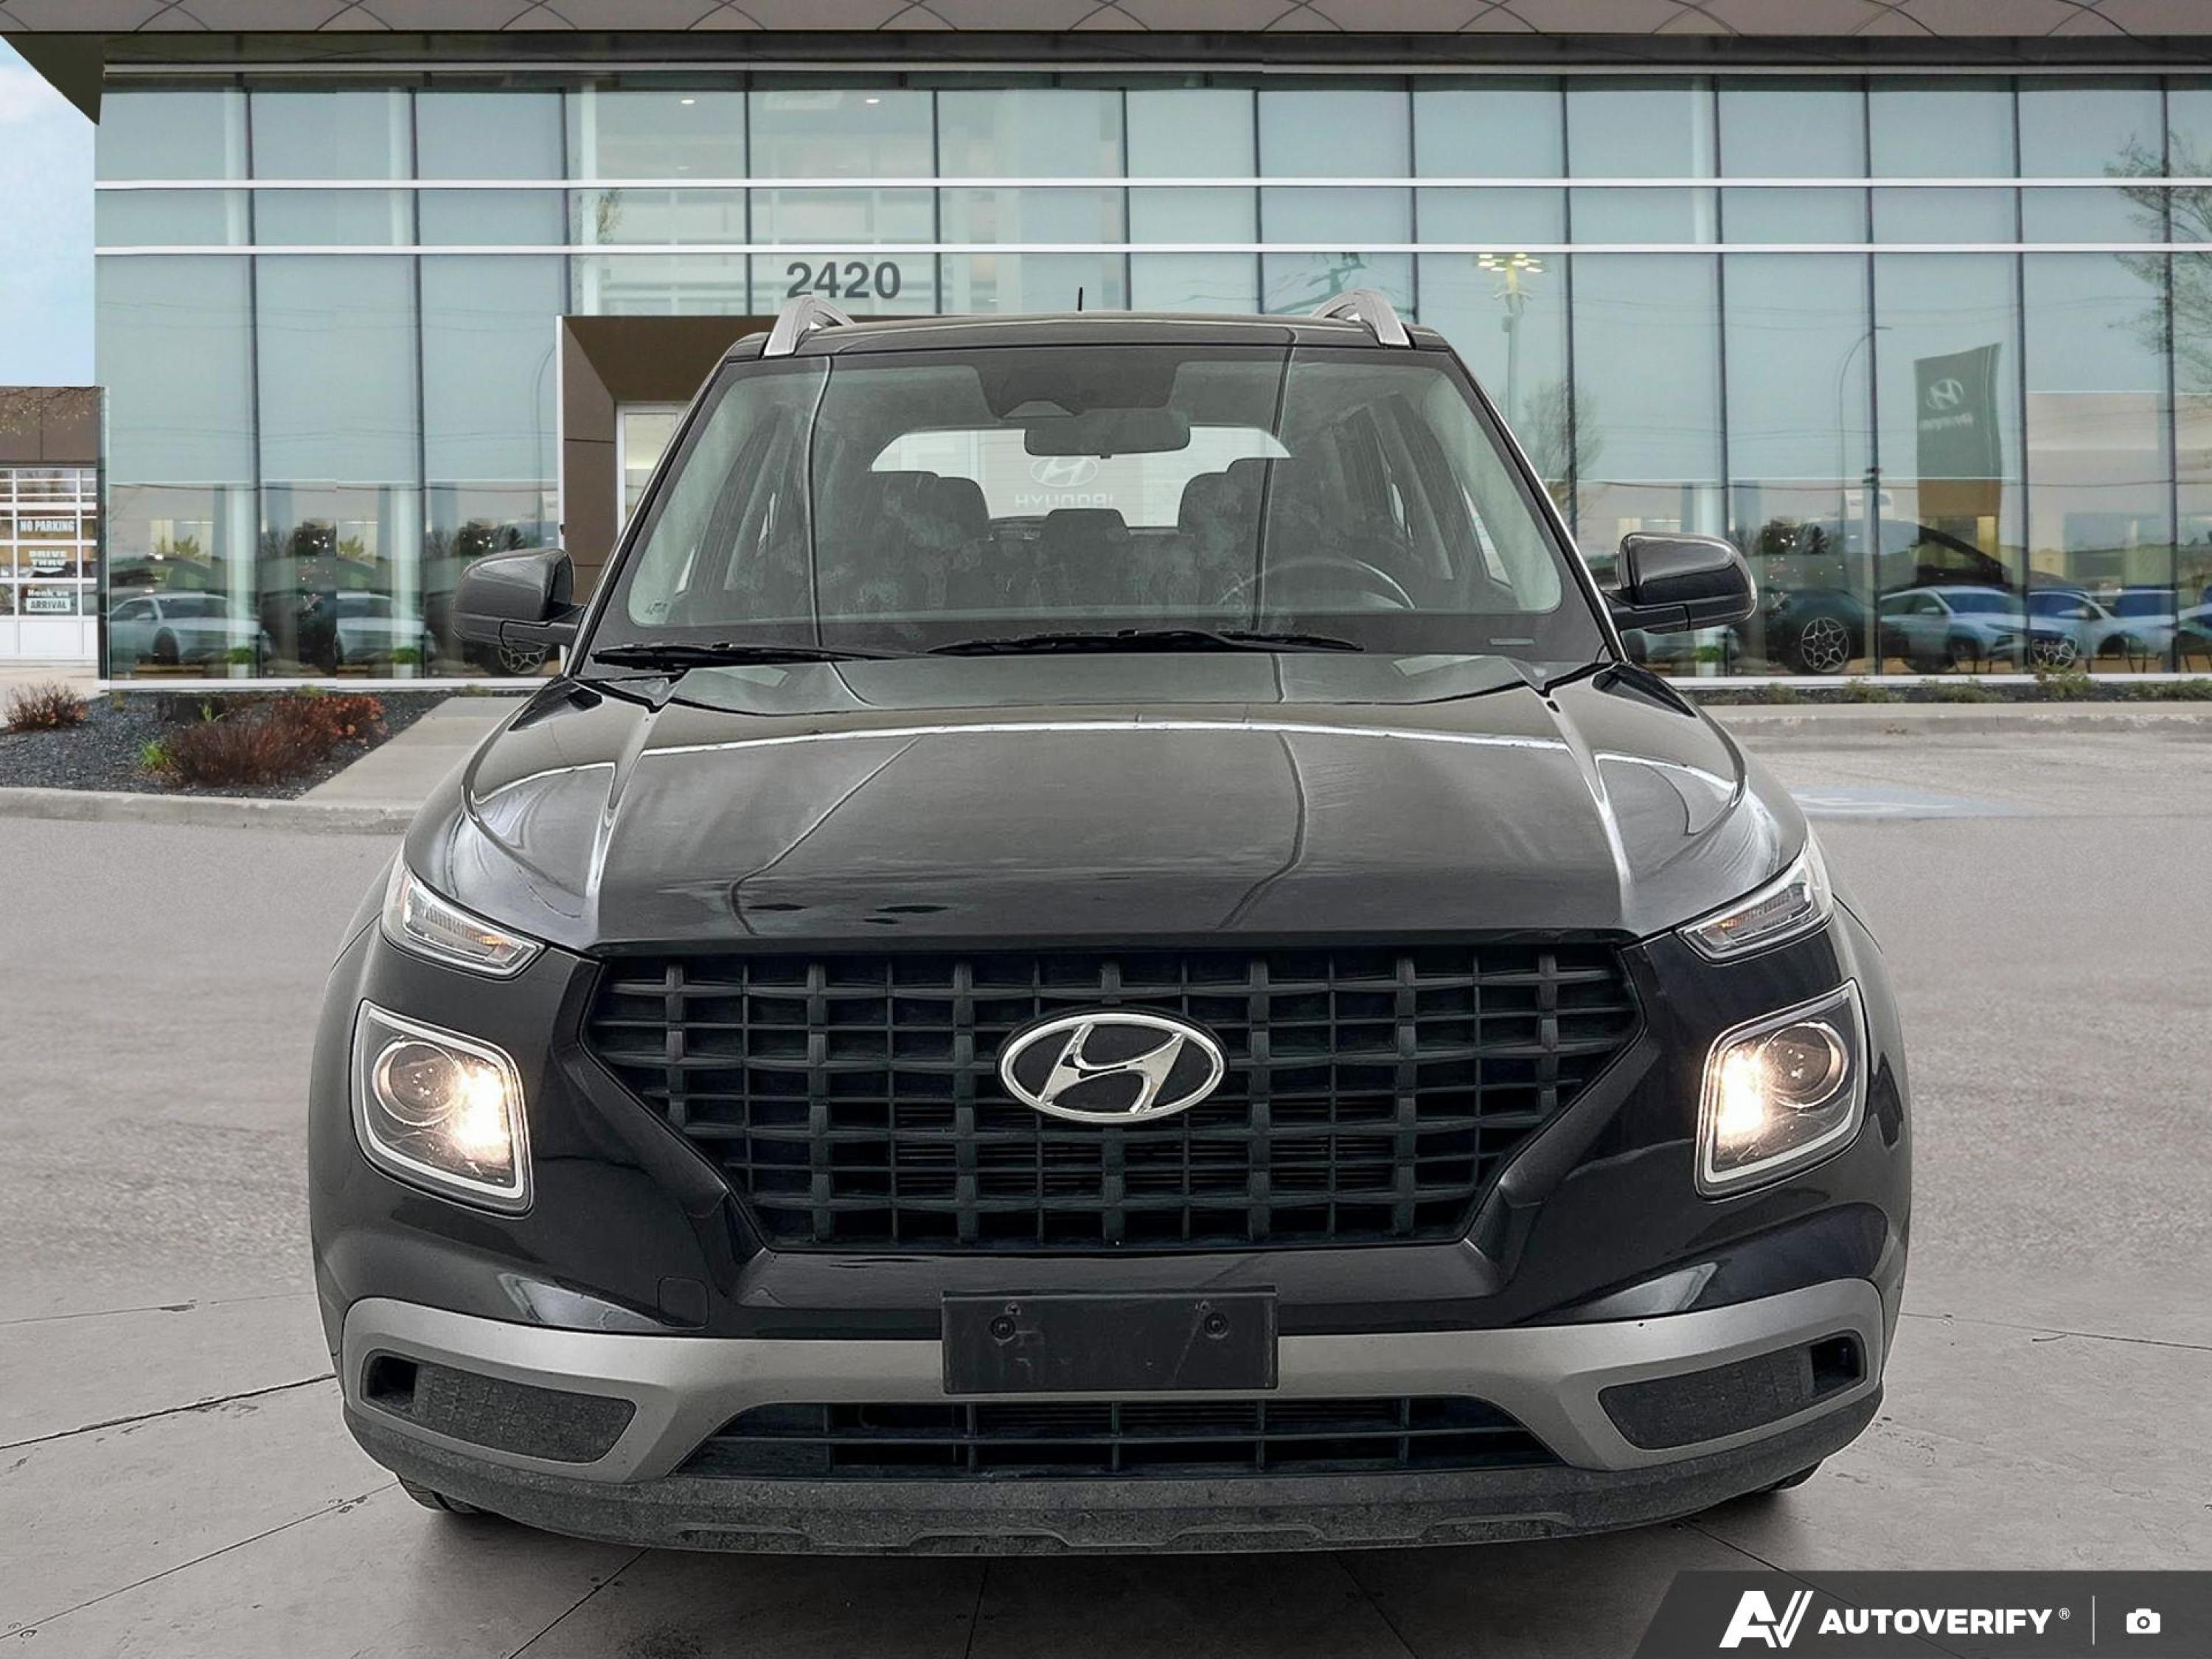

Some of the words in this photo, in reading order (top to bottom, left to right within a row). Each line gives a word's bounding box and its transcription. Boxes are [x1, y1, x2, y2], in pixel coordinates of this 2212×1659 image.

[787, 261, 901, 299] 2420
[20, 520, 32, 532] NO
[35, 520, 74, 532] PARKING
[28, 550, 67, 558] DRIVE
[30, 600, 67, 609] ARRIVAL
